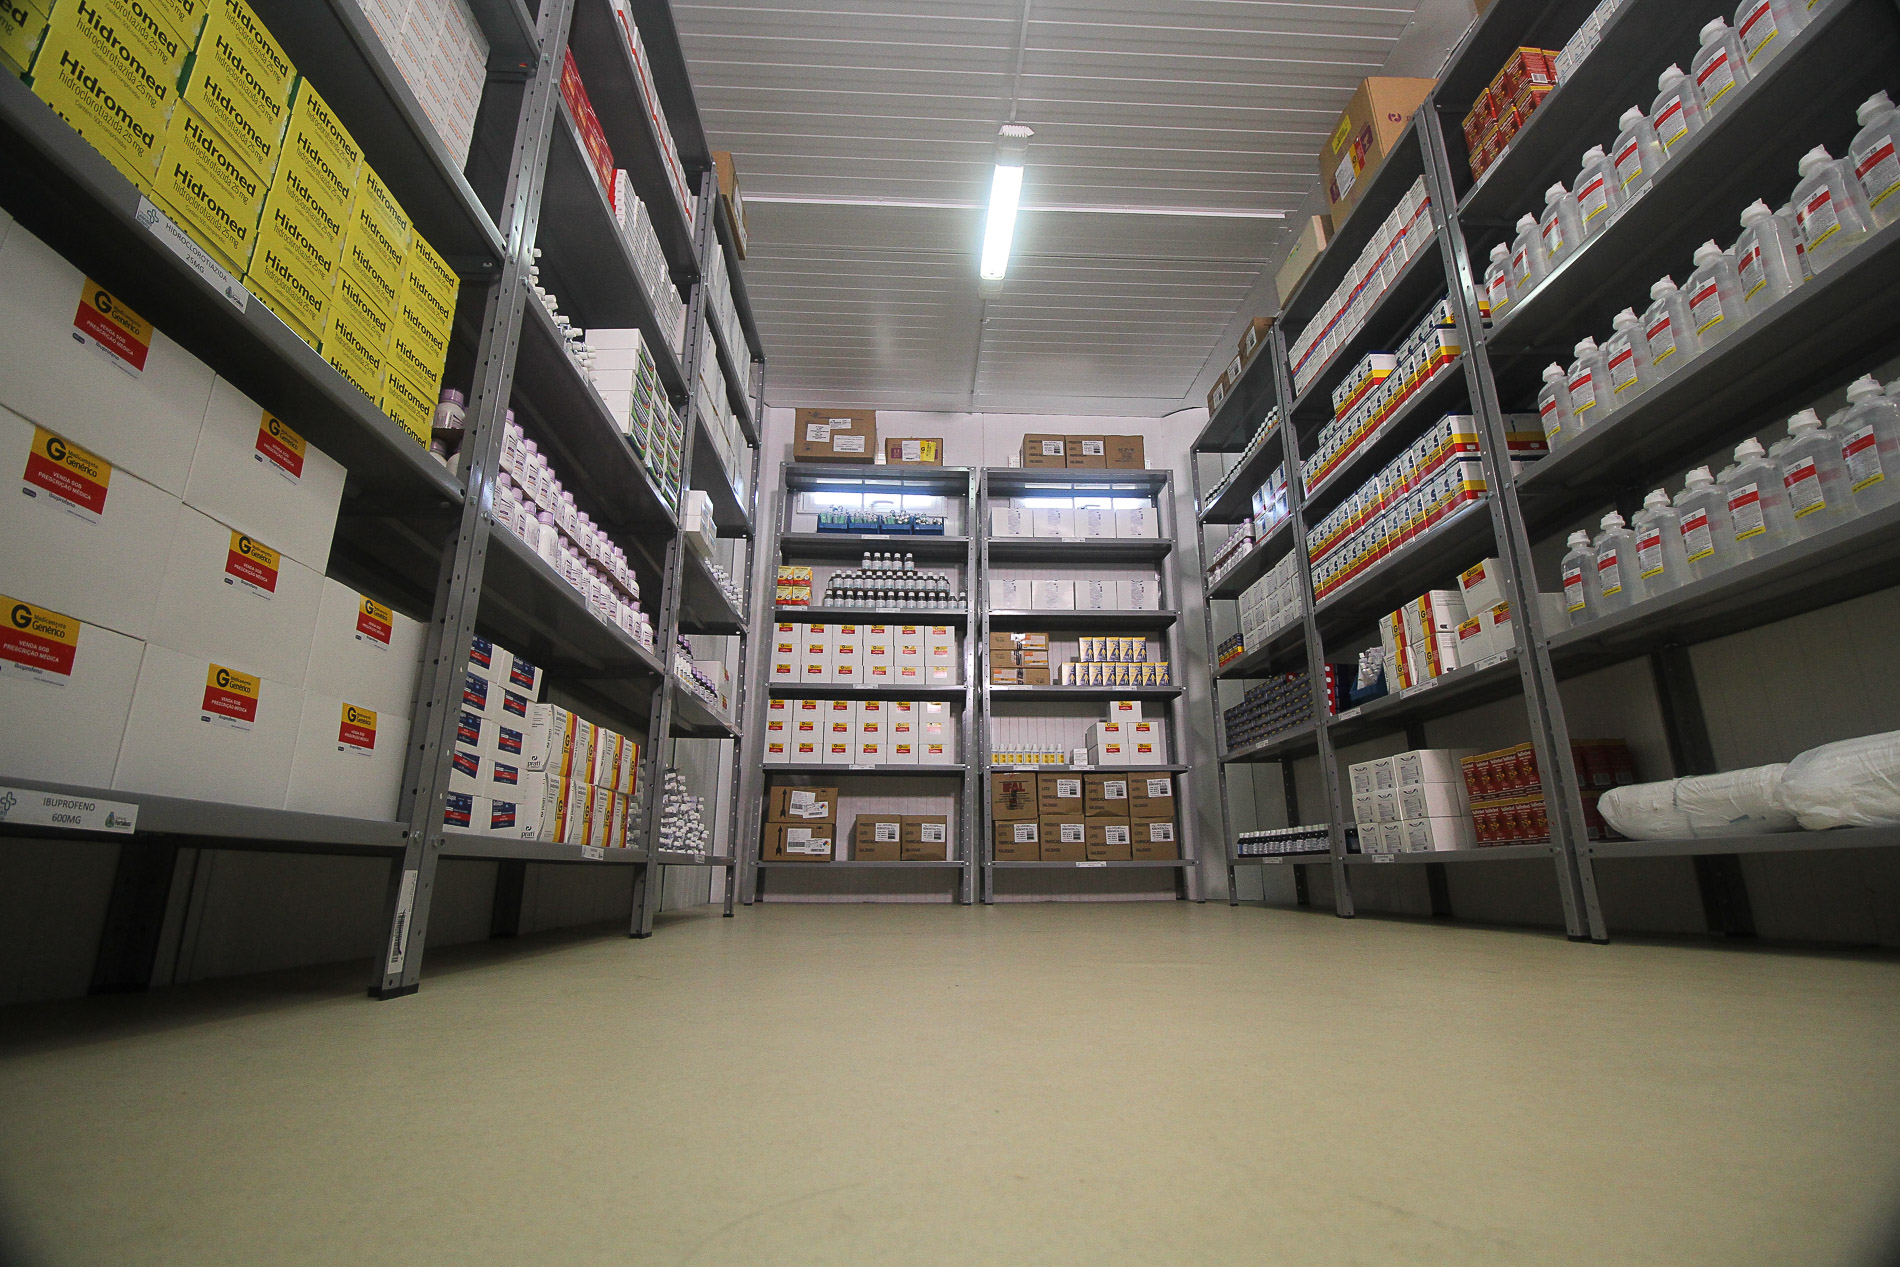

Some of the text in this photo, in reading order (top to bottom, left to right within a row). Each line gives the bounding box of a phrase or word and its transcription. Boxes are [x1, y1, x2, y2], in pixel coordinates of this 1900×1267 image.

[76, 17, 136, 84] hidroclorotiazida
[135, 81, 147, 95] 25
[77, 0, 167, 100] Hidromed
[148, 37, 158, 50] 25
[158, 50, 168, 65] mg
[225, 0, 288, 78] Hidromed
[216, 34, 280, 118] Hidromed
[266, 63, 274, 73] 25
[58, 70, 122, 134] hidroclorotiazida
[122, 128, 133, 144] 25
[60, 50, 154, 150] Hidromed
[204, 75, 270, 156] Hidromed
[256, 103, 264, 113] 25
[247, 142, 256, 151] 25
[307, 94, 357, 162] Hidromed
[184, 117, 256, 197] Hidromed
[297, 132, 350, 199] Hidromed
[173, 180, 222, 231] hidroclorotiazida
[221, 228, 230, 238] 25
[174, 163, 247, 241] Hidromed
[231, 183, 240, 192] 25
[287, 170, 340, 236] Hidromed
[366, 174, 407, 230] Hidromed
[166, 222, 228, 282] HIDROCLOROTIAZIDA
[274, 208, 331, 272] Hidromed
[360, 209, 402, 266] Hidromed
[186, 254, 205, 274] 25MG
[265, 250, 322, 312] Hidromed
[352, 245, 395, 300] Hidromed
[416, 240, 454, 288] Hidromed
[94, 291, 112, 313] G
[342, 280, 386, 333] Hidromed
[410, 272, 449, 319] Hidromed
[336, 318, 380, 370] Hidromed
[403, 305, 443, 351] Hidromed
[396, 338, 437, 383] Hidromed
[389, 373, 430, 416] Hidromed
[47, 438, 66, 461] G
[269, 418, 280, 436] G
[390, 409, 427, 450] Hidromed
[66, 456, 97, 478] Genérico
[239, 536, 251, 554] G
[11, 604, 32, 628] G
[32, 620, 65, 638] Genérico
[34, 614, 66, 629] Medicamento
[365, 600, 373, 614] G
[19, 640, 37, 650] VENDA
[217, 669, 229, 687] G
[230, 681, 251, 693] Genérico
[348, 707, 356, 722] G
[43, 797, 95, 812] IBUPROFENO
[52, 813, 81, 824] 600MG
